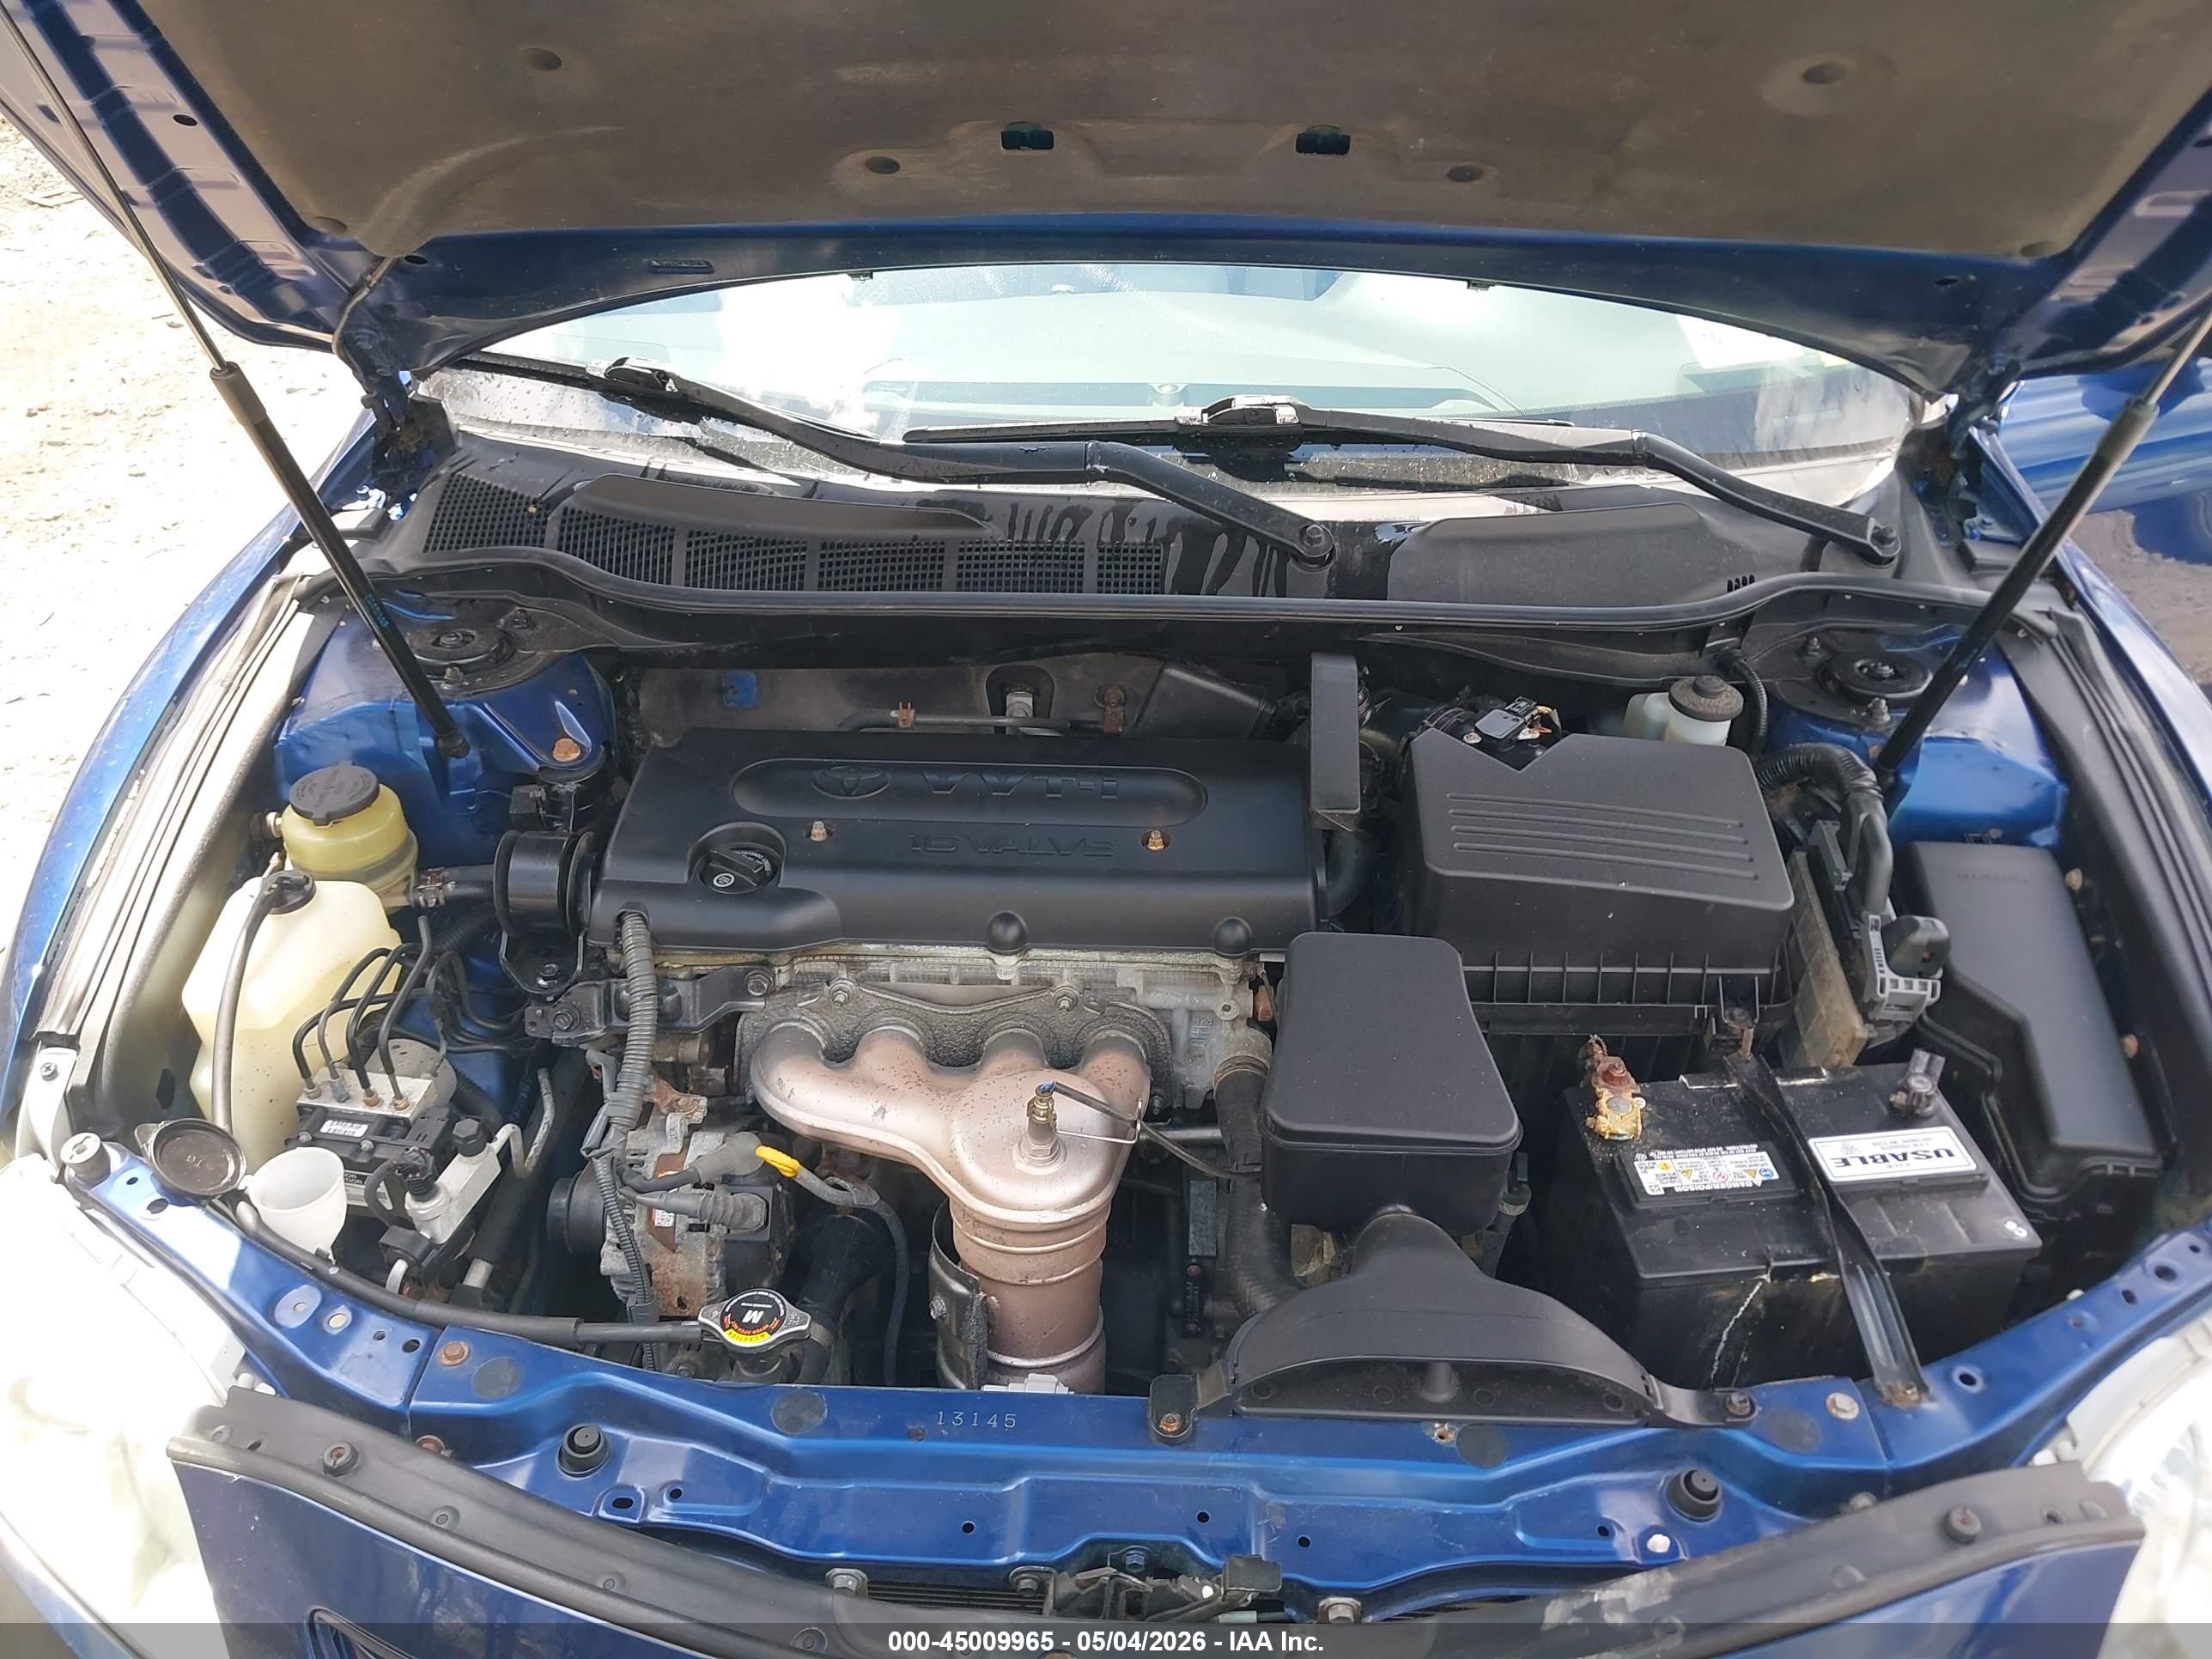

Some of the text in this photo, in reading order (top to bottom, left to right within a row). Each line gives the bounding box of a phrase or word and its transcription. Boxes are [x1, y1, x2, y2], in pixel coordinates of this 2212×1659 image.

[909, 835, 1115, 857] 16 VALVE
[1830, 1147, 1955, 1168] USABLE
[742, 1310, 764, 1323] M
[729, 1331, 761, 1341] CAUTION
[937, 1410, 1017, 1428] 13145
